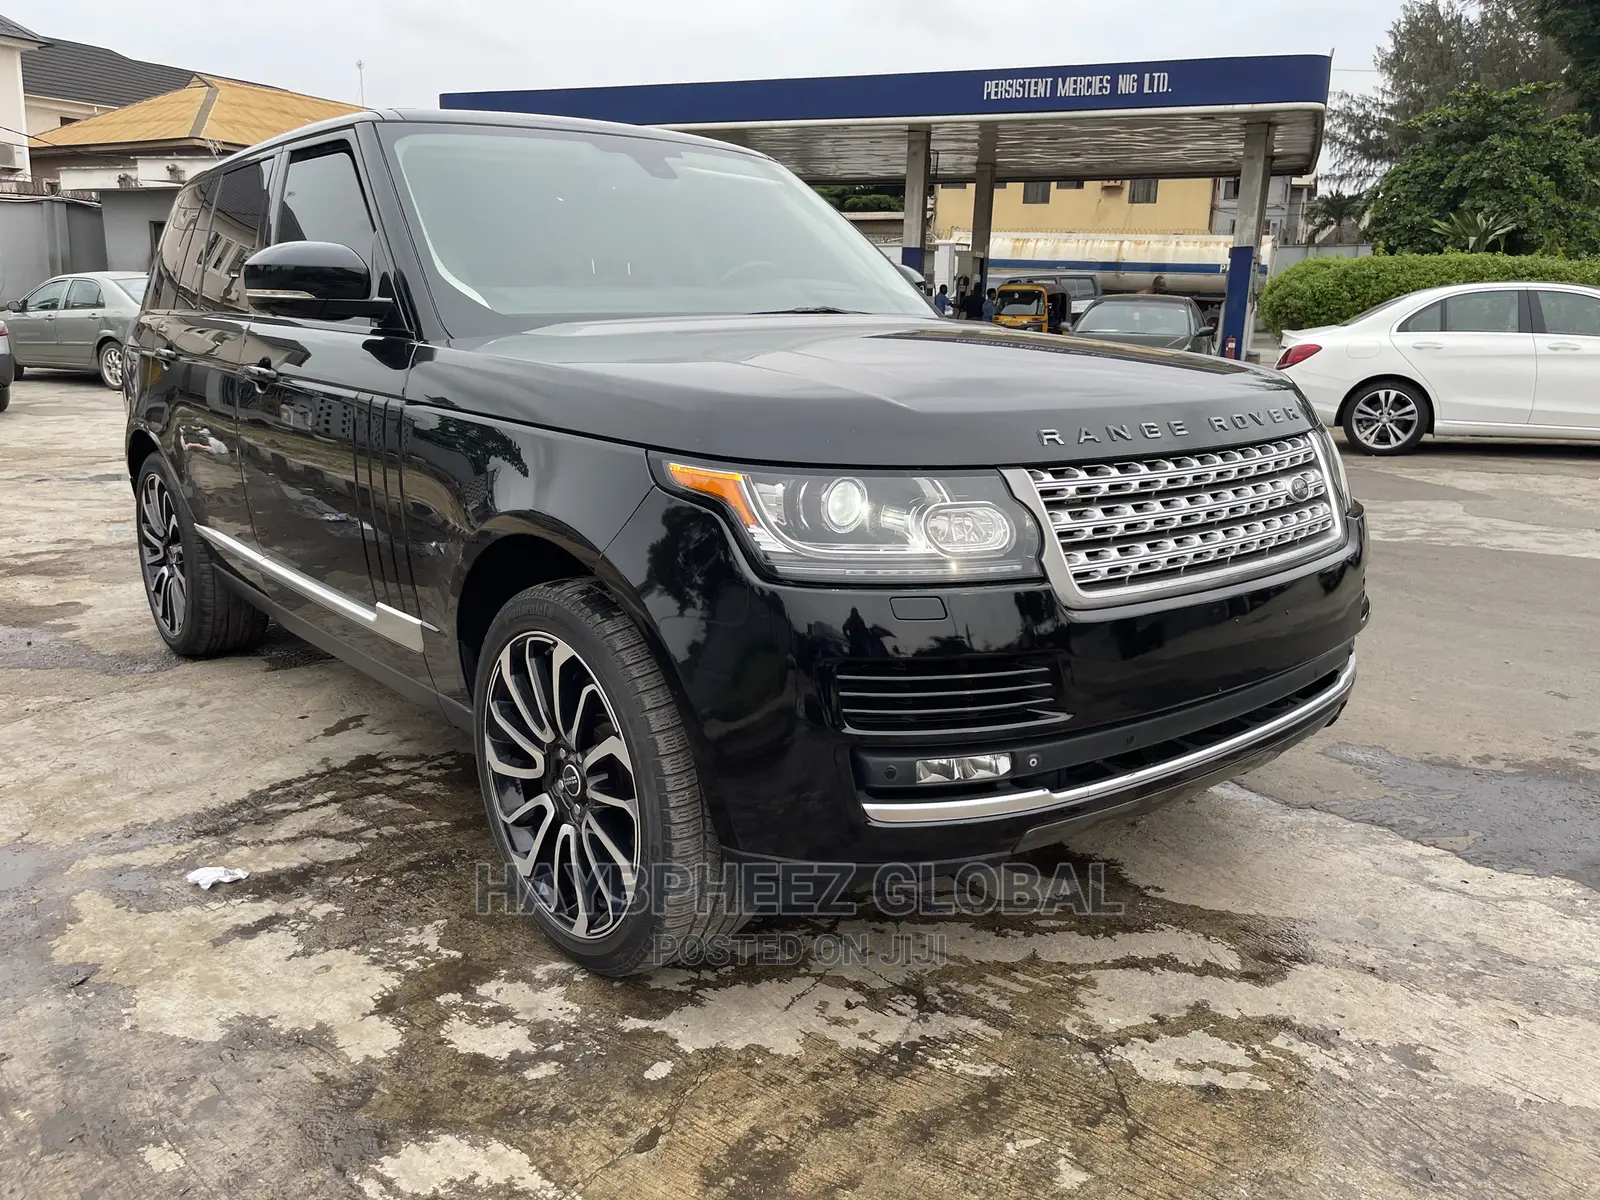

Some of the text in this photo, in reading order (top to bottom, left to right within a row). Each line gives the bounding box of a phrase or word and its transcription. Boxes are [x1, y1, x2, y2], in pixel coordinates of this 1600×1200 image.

[984, 72, 1172, 100] PERSISTENT MERCIES NIG LTD.
[1036, 406, 1300, 446] RANGE ROVER
